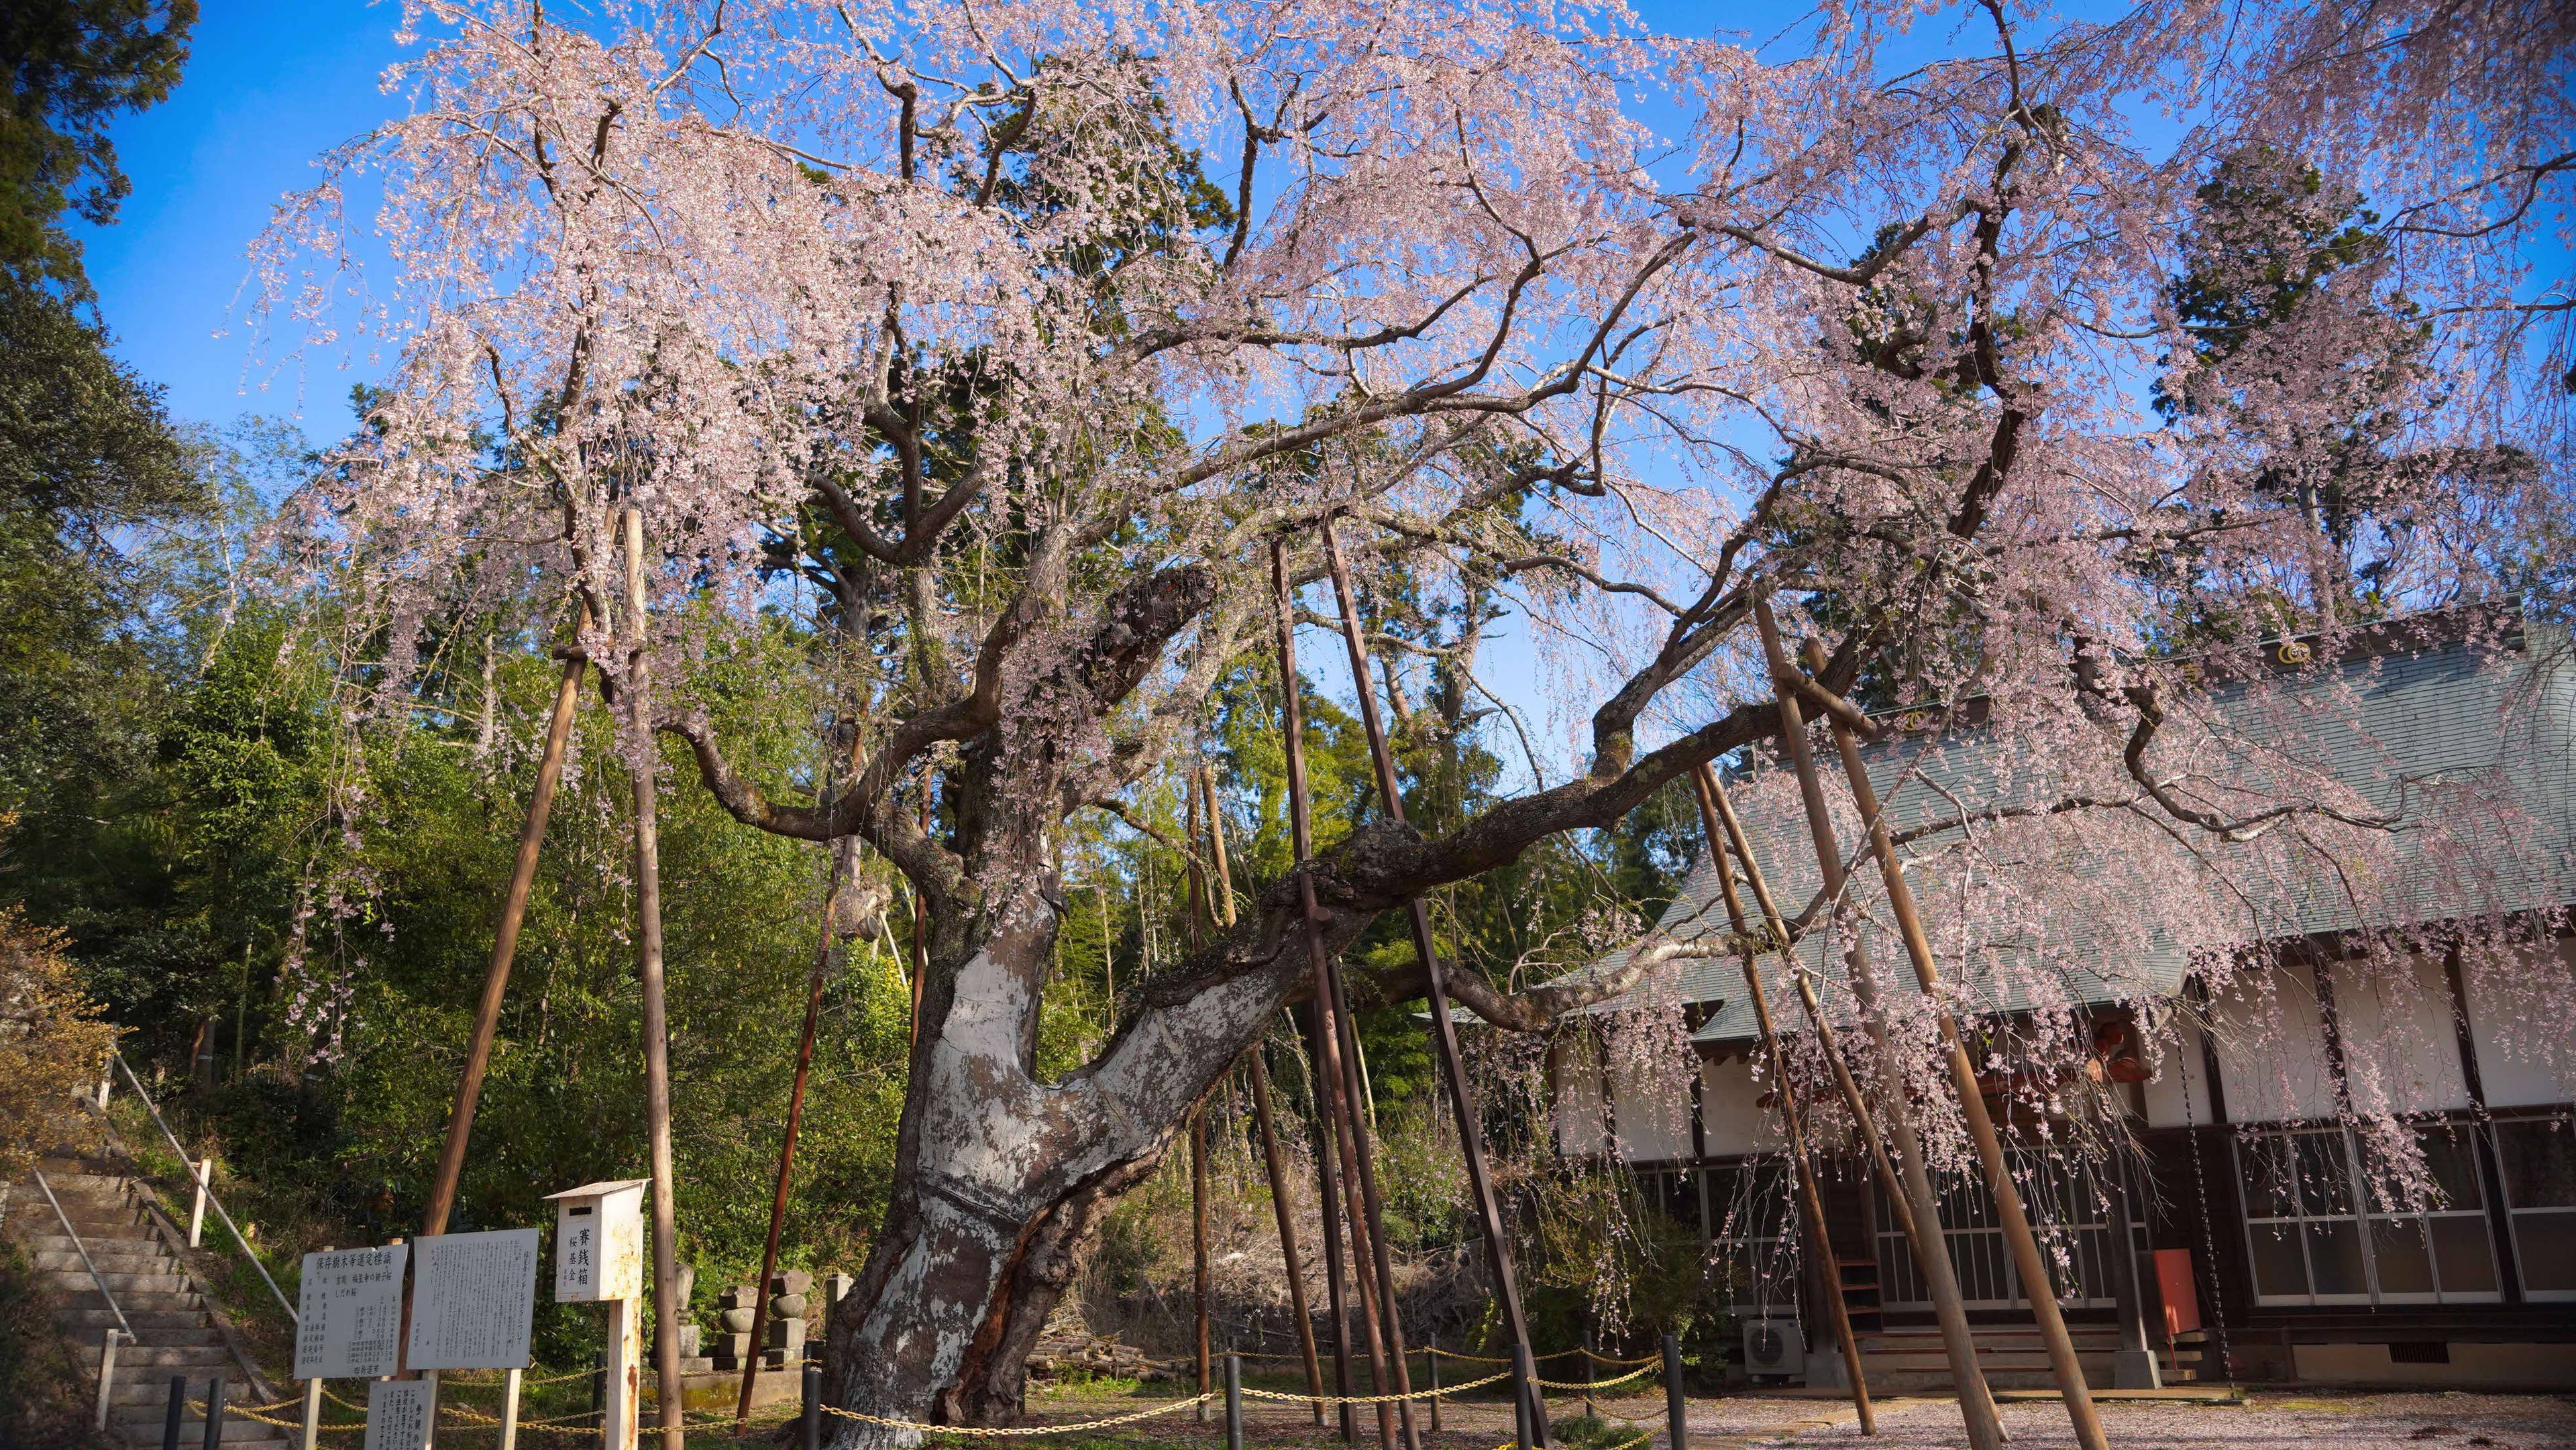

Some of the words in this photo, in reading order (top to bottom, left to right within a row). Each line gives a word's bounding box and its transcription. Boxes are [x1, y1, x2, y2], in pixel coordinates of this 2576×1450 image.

[568, 1236, 578, 1281] 桜基金
[578, 1228, 590, 1286] 賽銭箱
